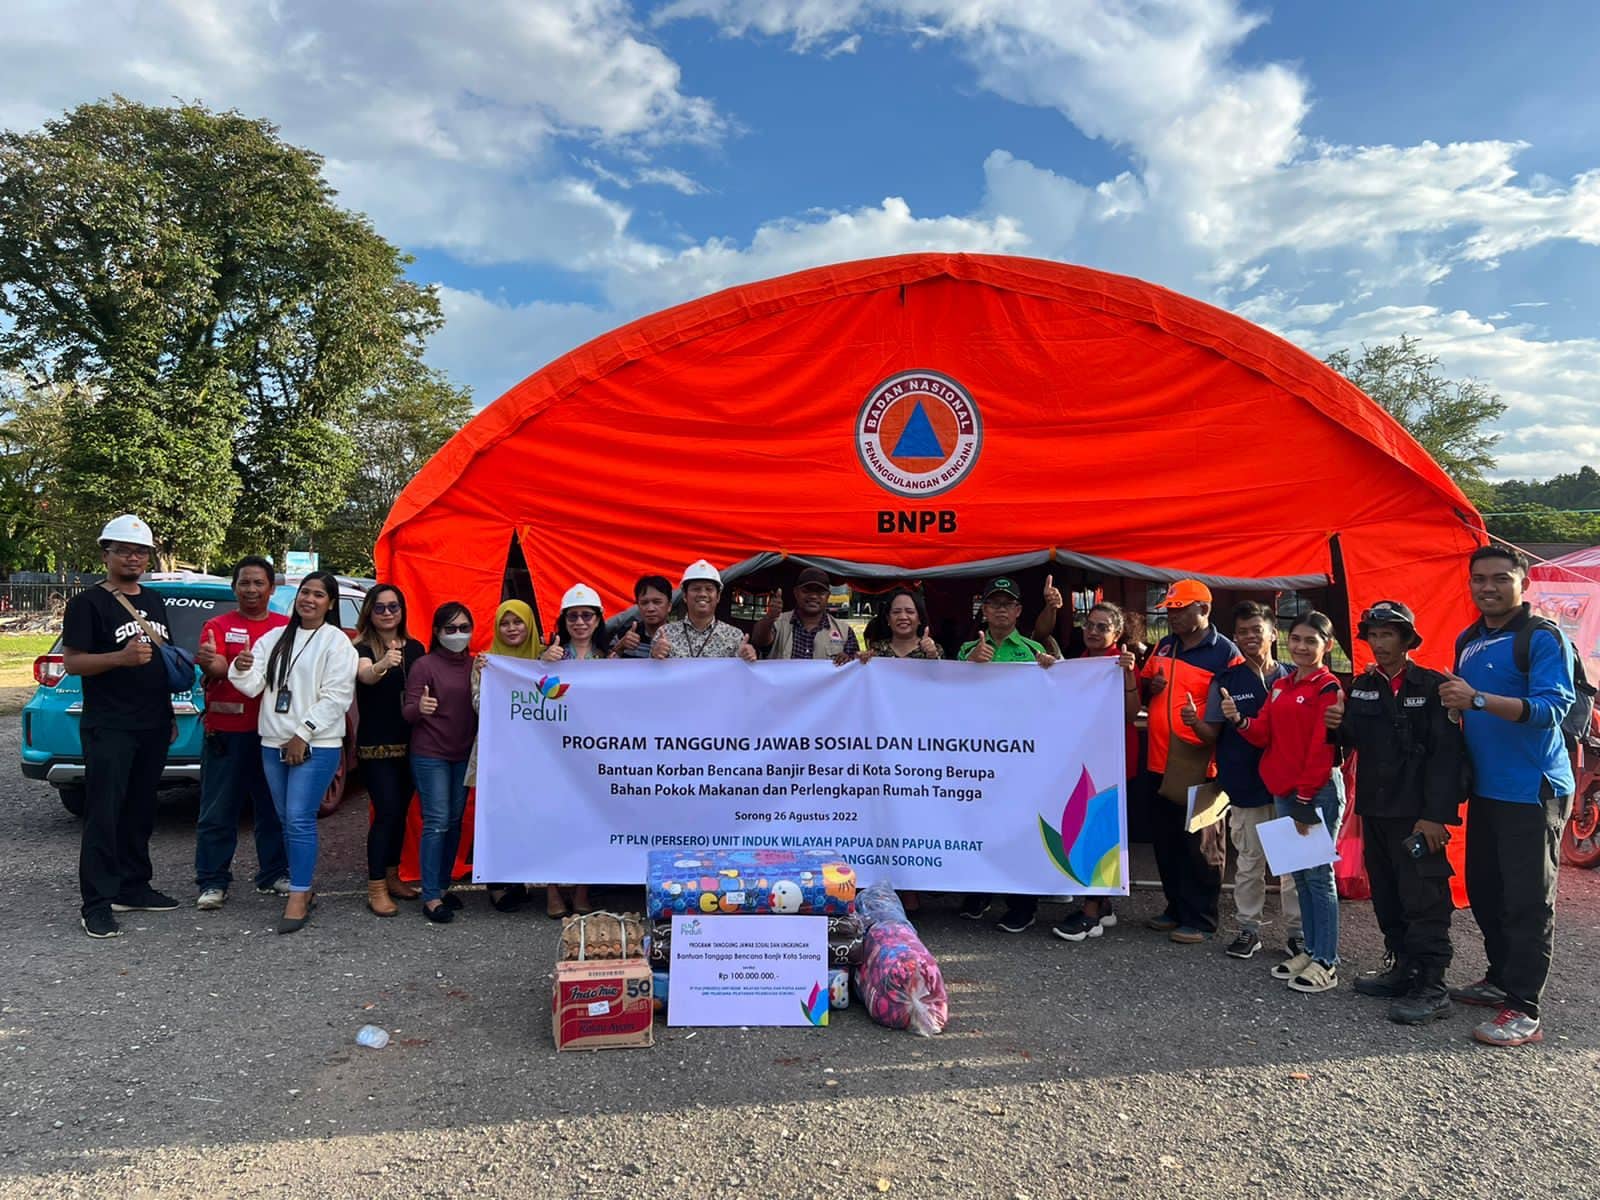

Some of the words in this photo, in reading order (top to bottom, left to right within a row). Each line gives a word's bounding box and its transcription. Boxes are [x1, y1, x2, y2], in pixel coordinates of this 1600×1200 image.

[867, 384, 903, 428] BADAN
[909, 380, 971, 429] NASIONAL
[864, 441, 940, 489] PENANGGULANGAN
[941, 441, 974, 481] BENCANA
[877, 511, 957, 533] BNPB
[115, 620, 169, 643] SORNG
[511, 690, 540, 704] PLN
[510, 703, 568, 721] Peduli
[562, 736, 647, 750] PROGRAM
[654, 737, 751, 751] TANGGUNG
[754, 737, 811, 751] JAWAB
[814, 736, 873, 750] SOSIAL
[876, 736, 913, 751] DAN
[917, 737, 1035, 753] LINGKUNGAN
[598, 763, 653, 776] Bantuan
[656, 763, 704, 776] Korban
[708, 764, 763, 776] Bencana
[766, 764, 805, 779] Banjir
[808, 764, 844, 776] Besar
[847, 763, 860, 776] di
[863, 764, 891, 776] Kota
[894, 764, 943, 780] Sorong
[946, 766, 995, 780] Berupa
[610, 783, 651, 796] Bahan
[654, 784, 696, 796] Pokok
[699, 784, 760, 796] Makanan
[763, 783, 788, 796] dan
[791, 783, 880, 799] Perlengkapan
[883, 784, 930, 798] Rumah
[932, 785, 983, 801] Tangga
[735, 811, 772, 823] Sorong
[774, 811, 787, 821] 26
[789, 811, 830, 823] Agustus
[832, 811, 858, 822] 2022
[610, 834, 624, 845] PT
[626, 834, 649, 846] PLN
[651, 834, 710, 848] (PERSERO)
[712, 836, 740, 847] UNIT
[742, 836, 779, 848] INDUK
[781, 836, 832, 848] WILAYAH
[835, 837, 874, 849] PAPUA
[876, 837, 900, 849] DAN
[902, 839, 942, 850] PAPUA
[944, 840, 984, 852] BARAT
[839, 854, 890, 866] ANGGAN
[892, 855, 943, 868] SORONG
[677, 952, 704, 960] Bantuan
[704, 952, 733, 961] Tanggap
[734, 952, 763, 960] Bencana
[764, 952, 781, 961] Banjir
[783, 952, 798, 960] Kota
[799, 952, 821, 961] Sorong
[718, 971, 729, 981] Rp
